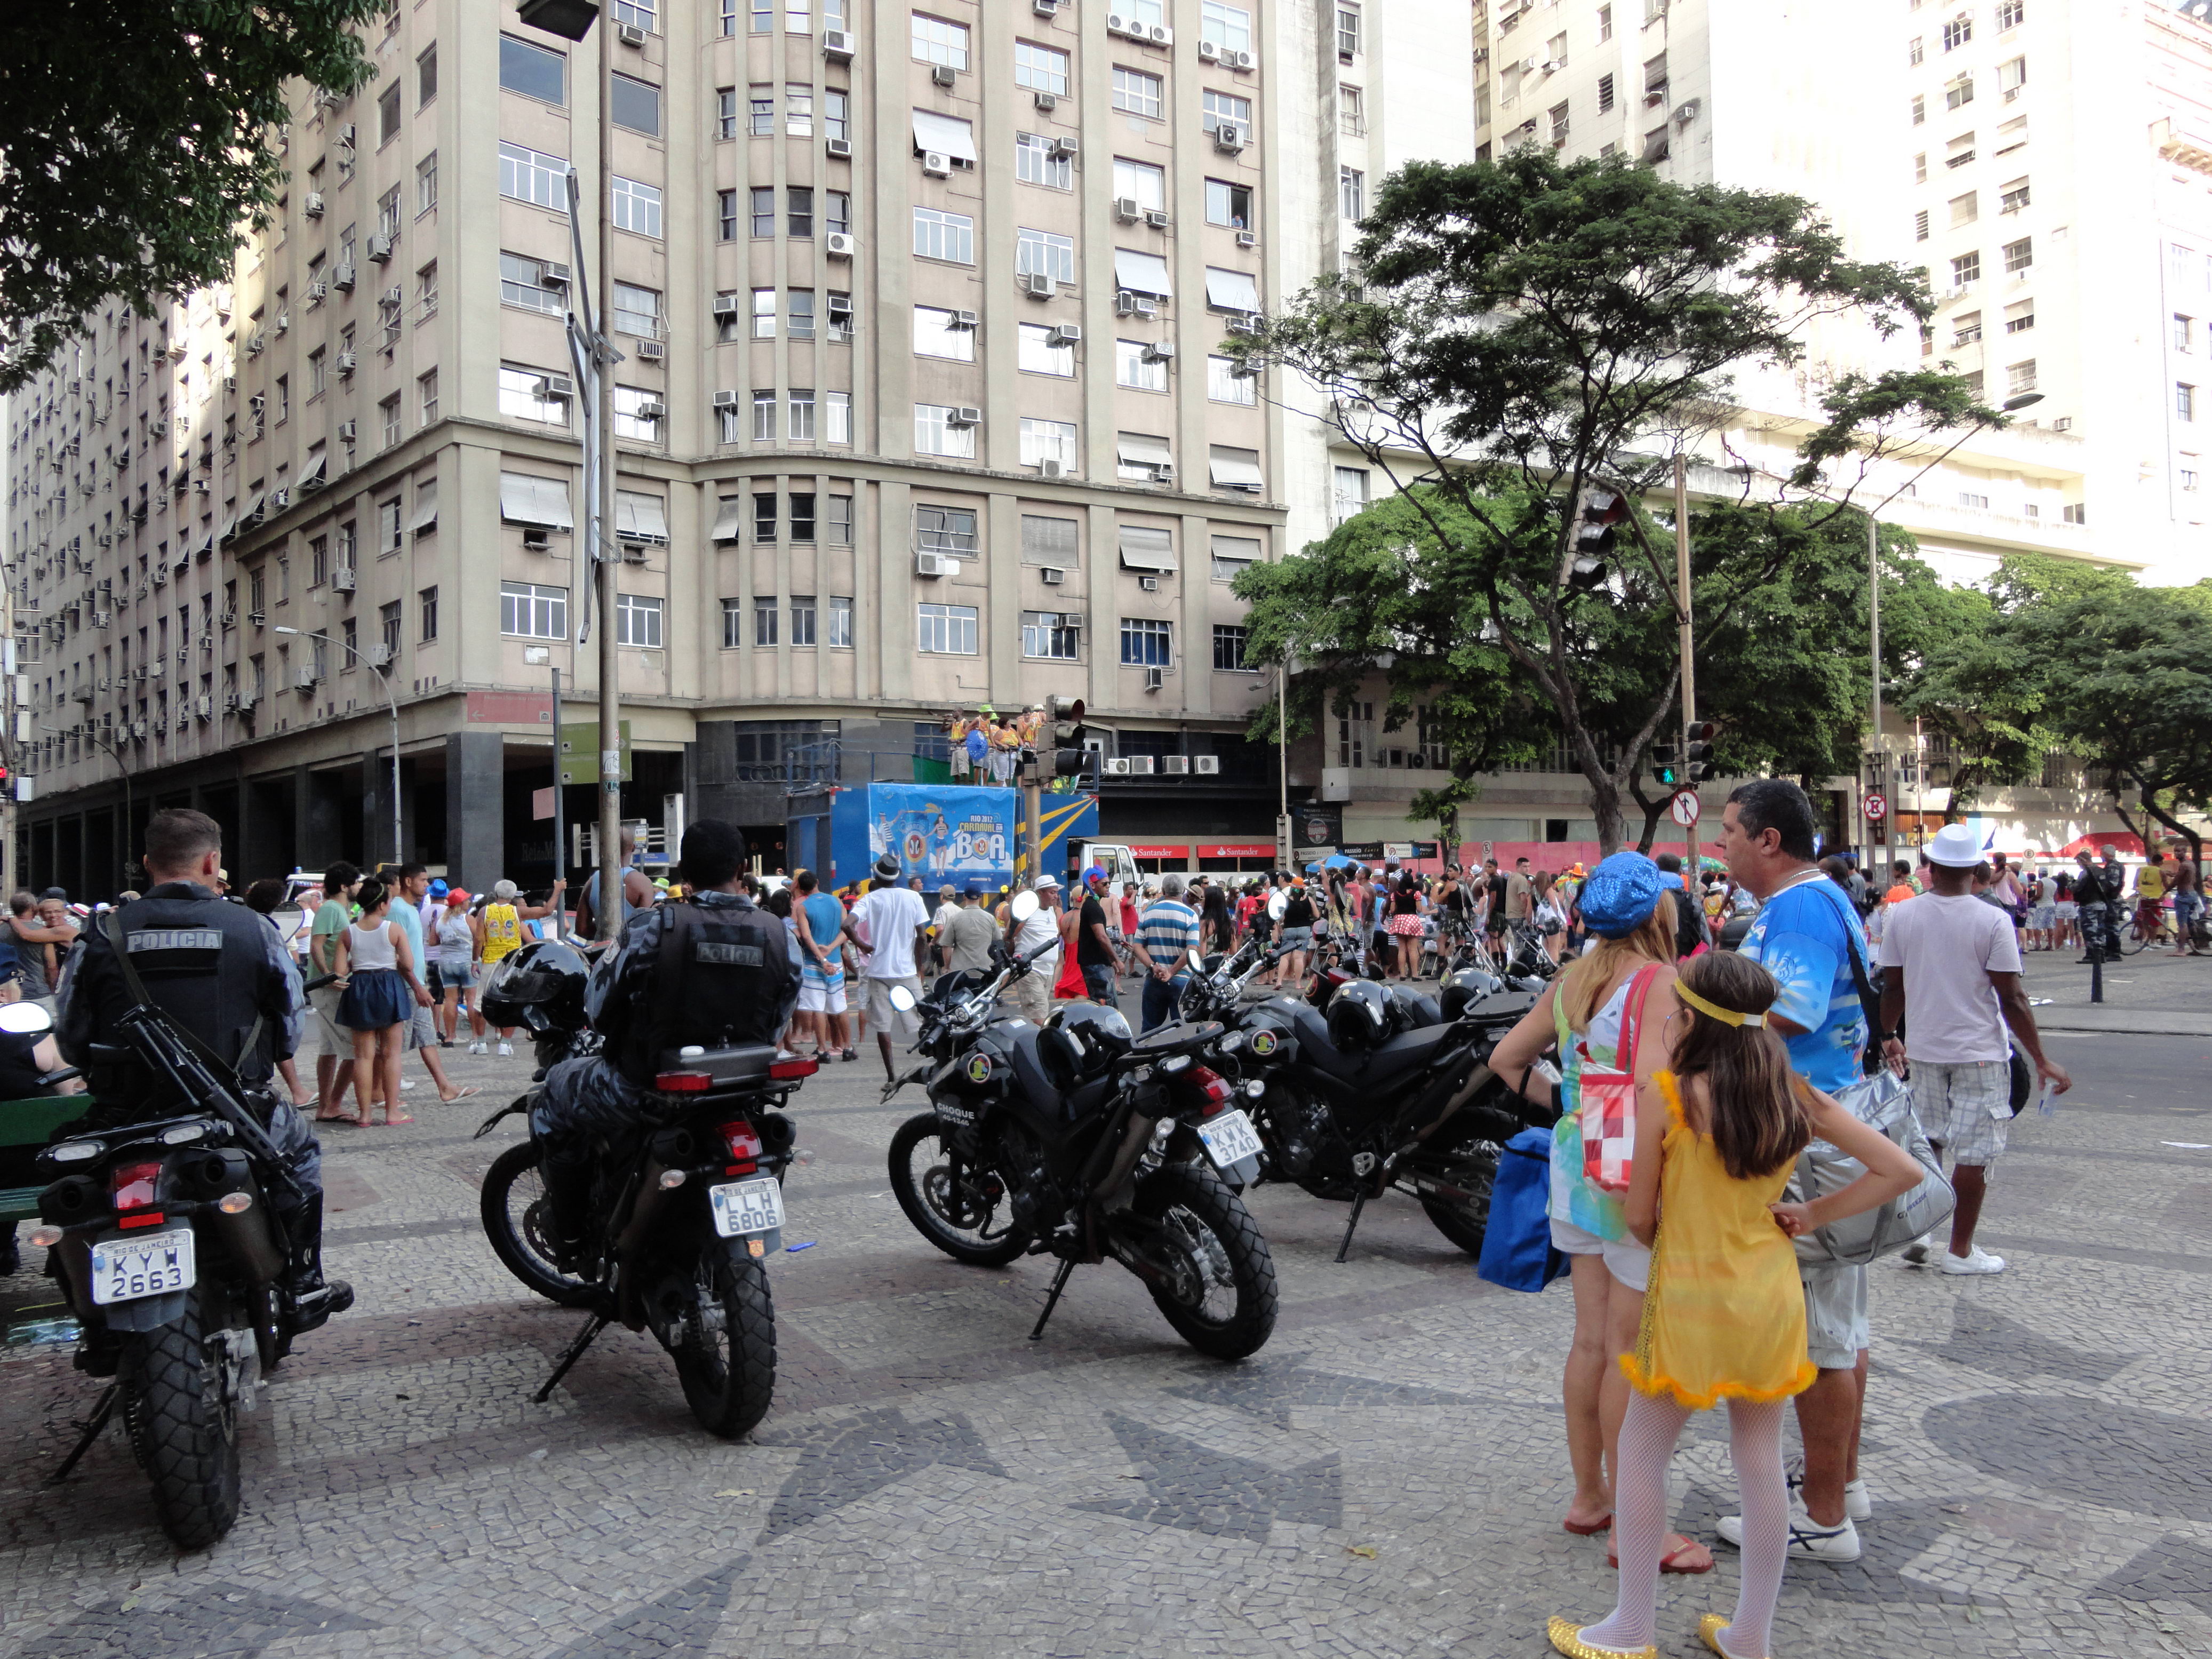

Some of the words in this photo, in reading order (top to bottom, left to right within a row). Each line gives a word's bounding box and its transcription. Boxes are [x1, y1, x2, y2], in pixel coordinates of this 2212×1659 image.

[959, 823, 996, 832] CARNAVAL
[1138, 848, 1172, 857] Santander
[1226, 847, 1258, 856] Santander
[128, 931, 220, 951] POLÍCIA
[937, 1103, 975, 1119] CHOQUE
[1212, 1122, 1248, 1148] KWK
[1219, 1136, 1257, 1161] 3740
[744, 1184, 767, 1193] JANEIRO
[725, 1192, 773, 1214] LLH
[728, 1209, 777, 1232] 6806
[141, 1239, 175, 1250] JANEIRO
[113, 1247, 178, 1277] KYW
[111, 1267, 182, 1297] 2663
